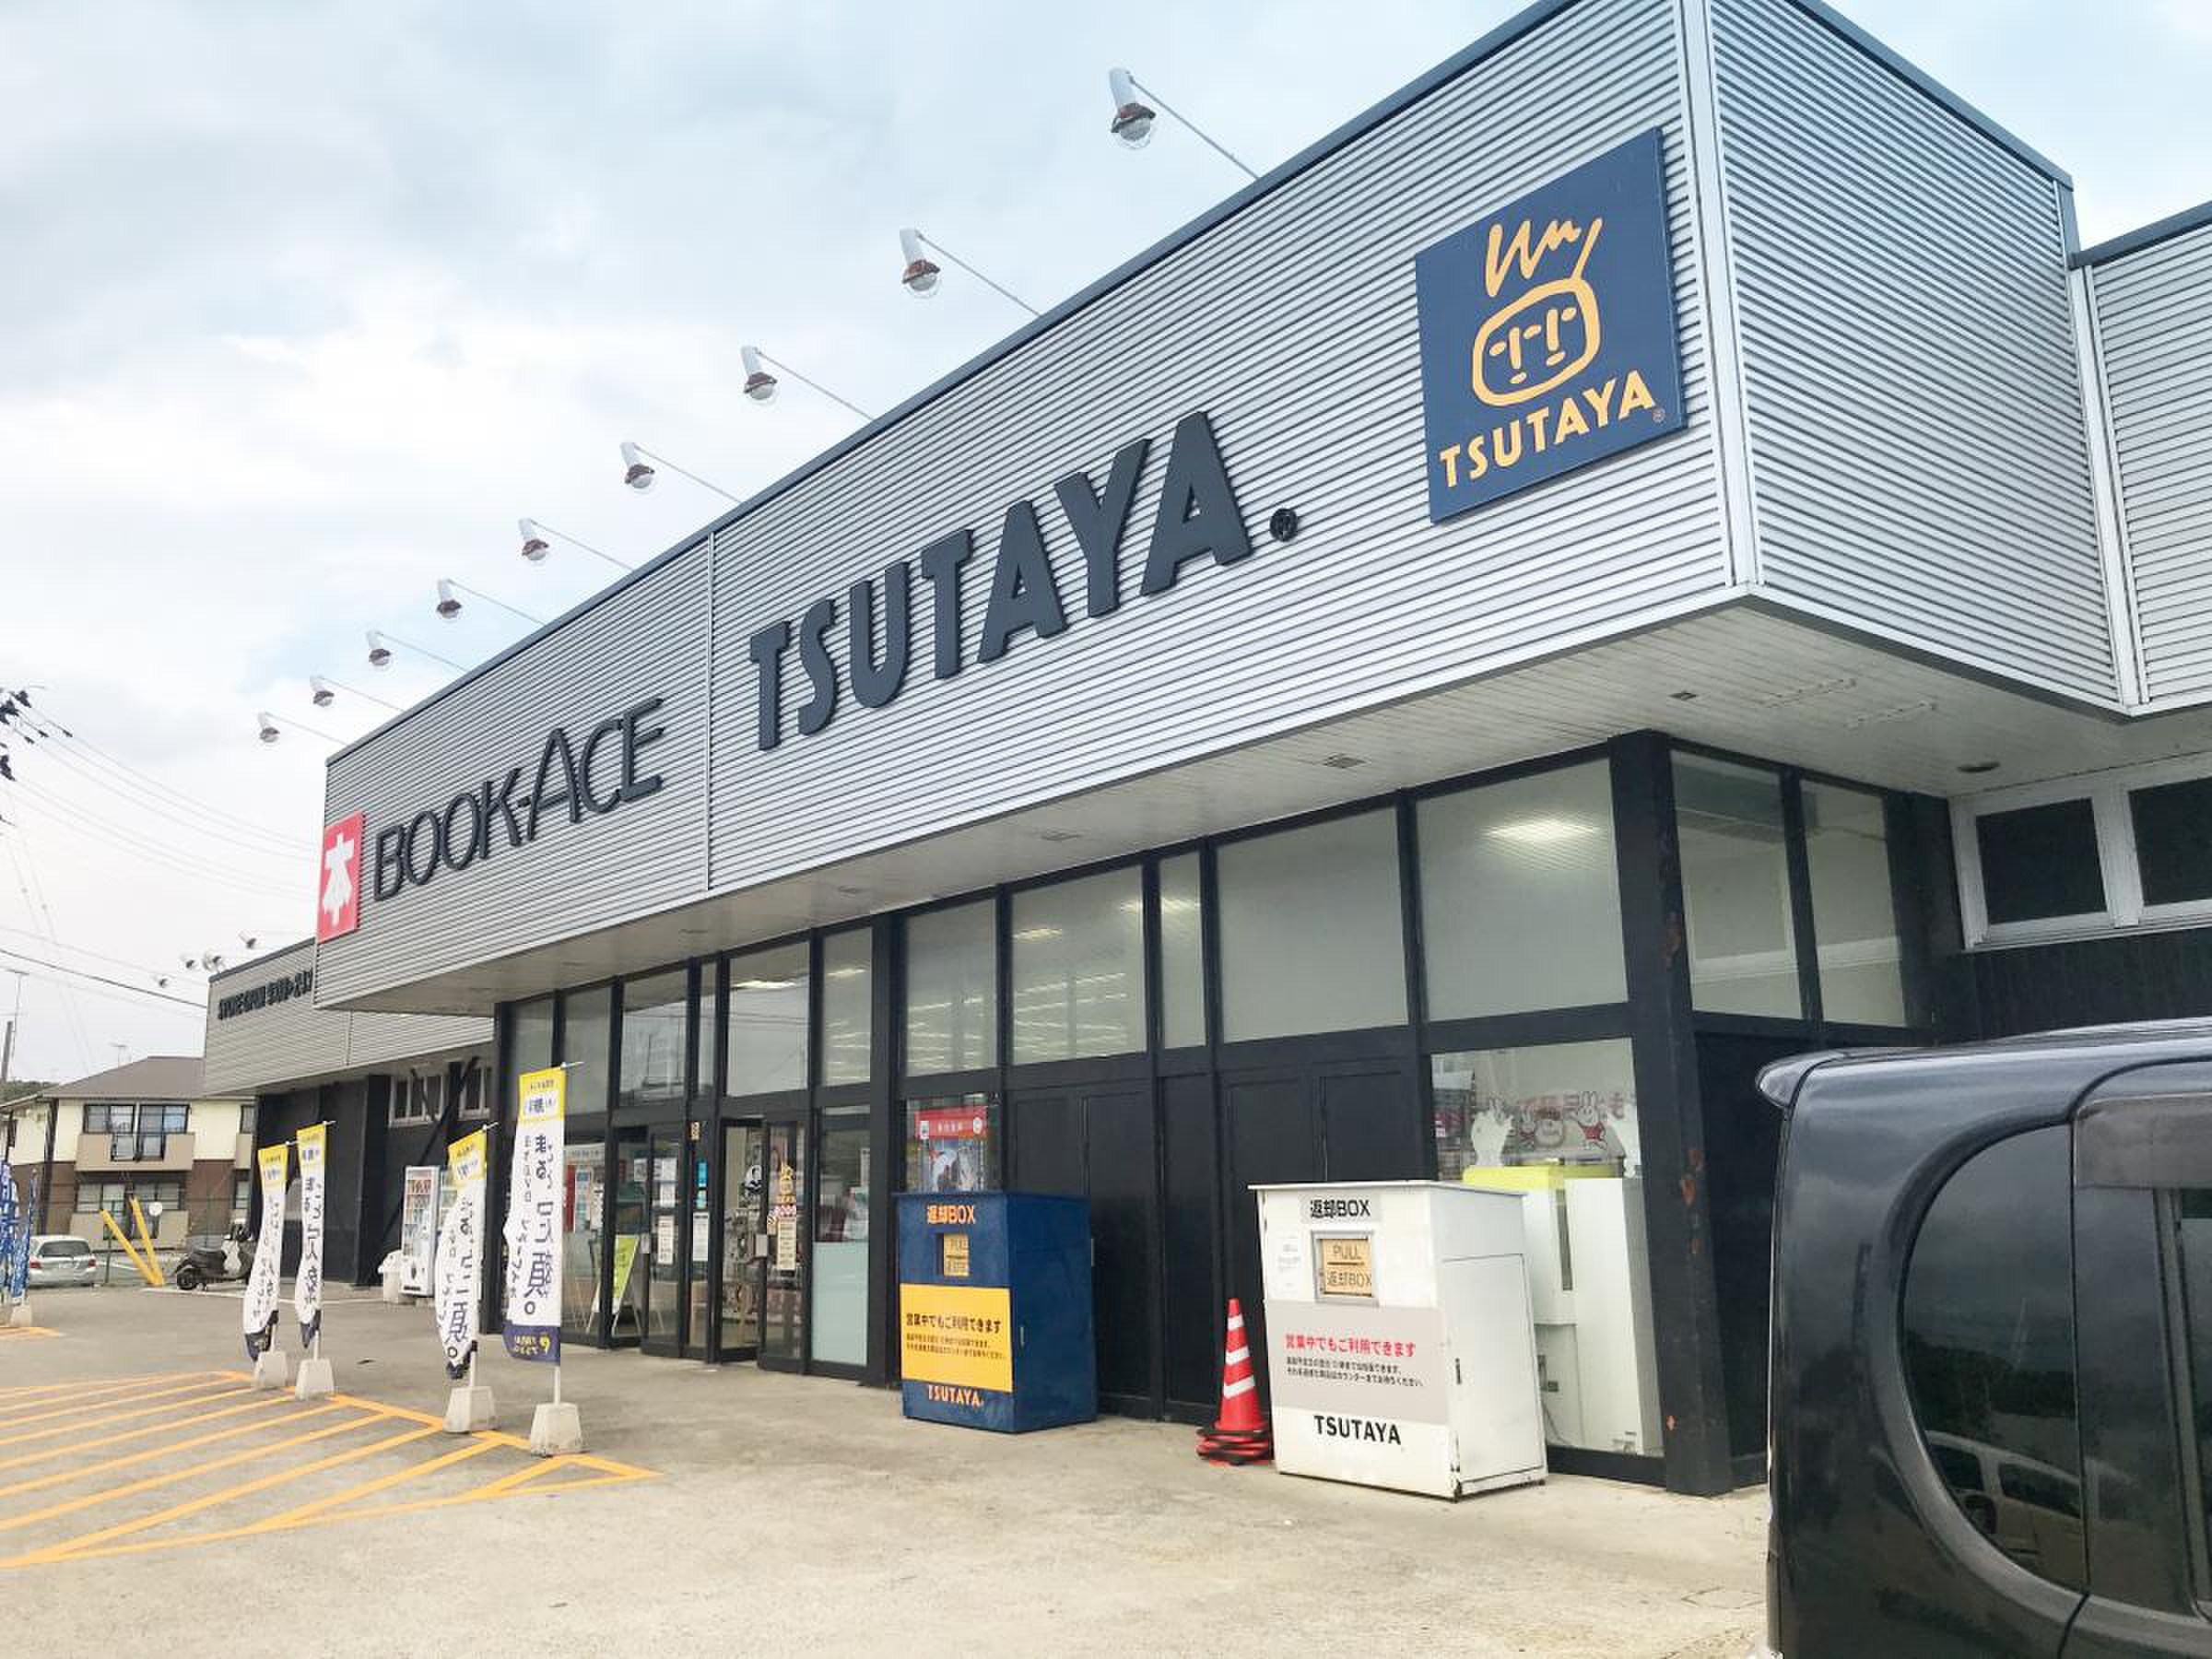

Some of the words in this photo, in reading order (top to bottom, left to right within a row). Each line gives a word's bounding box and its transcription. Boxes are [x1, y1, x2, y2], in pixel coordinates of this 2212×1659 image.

[1440, 370, 1656, 488] TSUTAYA
[750, 410, 1256, 752] TSUTAYA
[373, 697, 665, 902] BOOK-ACE
[1310, 1198, 1371, 1219] 返却BOX
[1332, 1244, 1363, 1261] PULL
[1326, 1270, 1373, 1288] 返却BOX
[906, 1312, 1002, 1335] 営業中でもご利用できます
[1286, 1334, 1417, 1358] 営業中でもご利用できます
[928, 1384, 982, 1407] TSUTAYA
[1313, 1414, 1402, 1446] TSUTAYA
